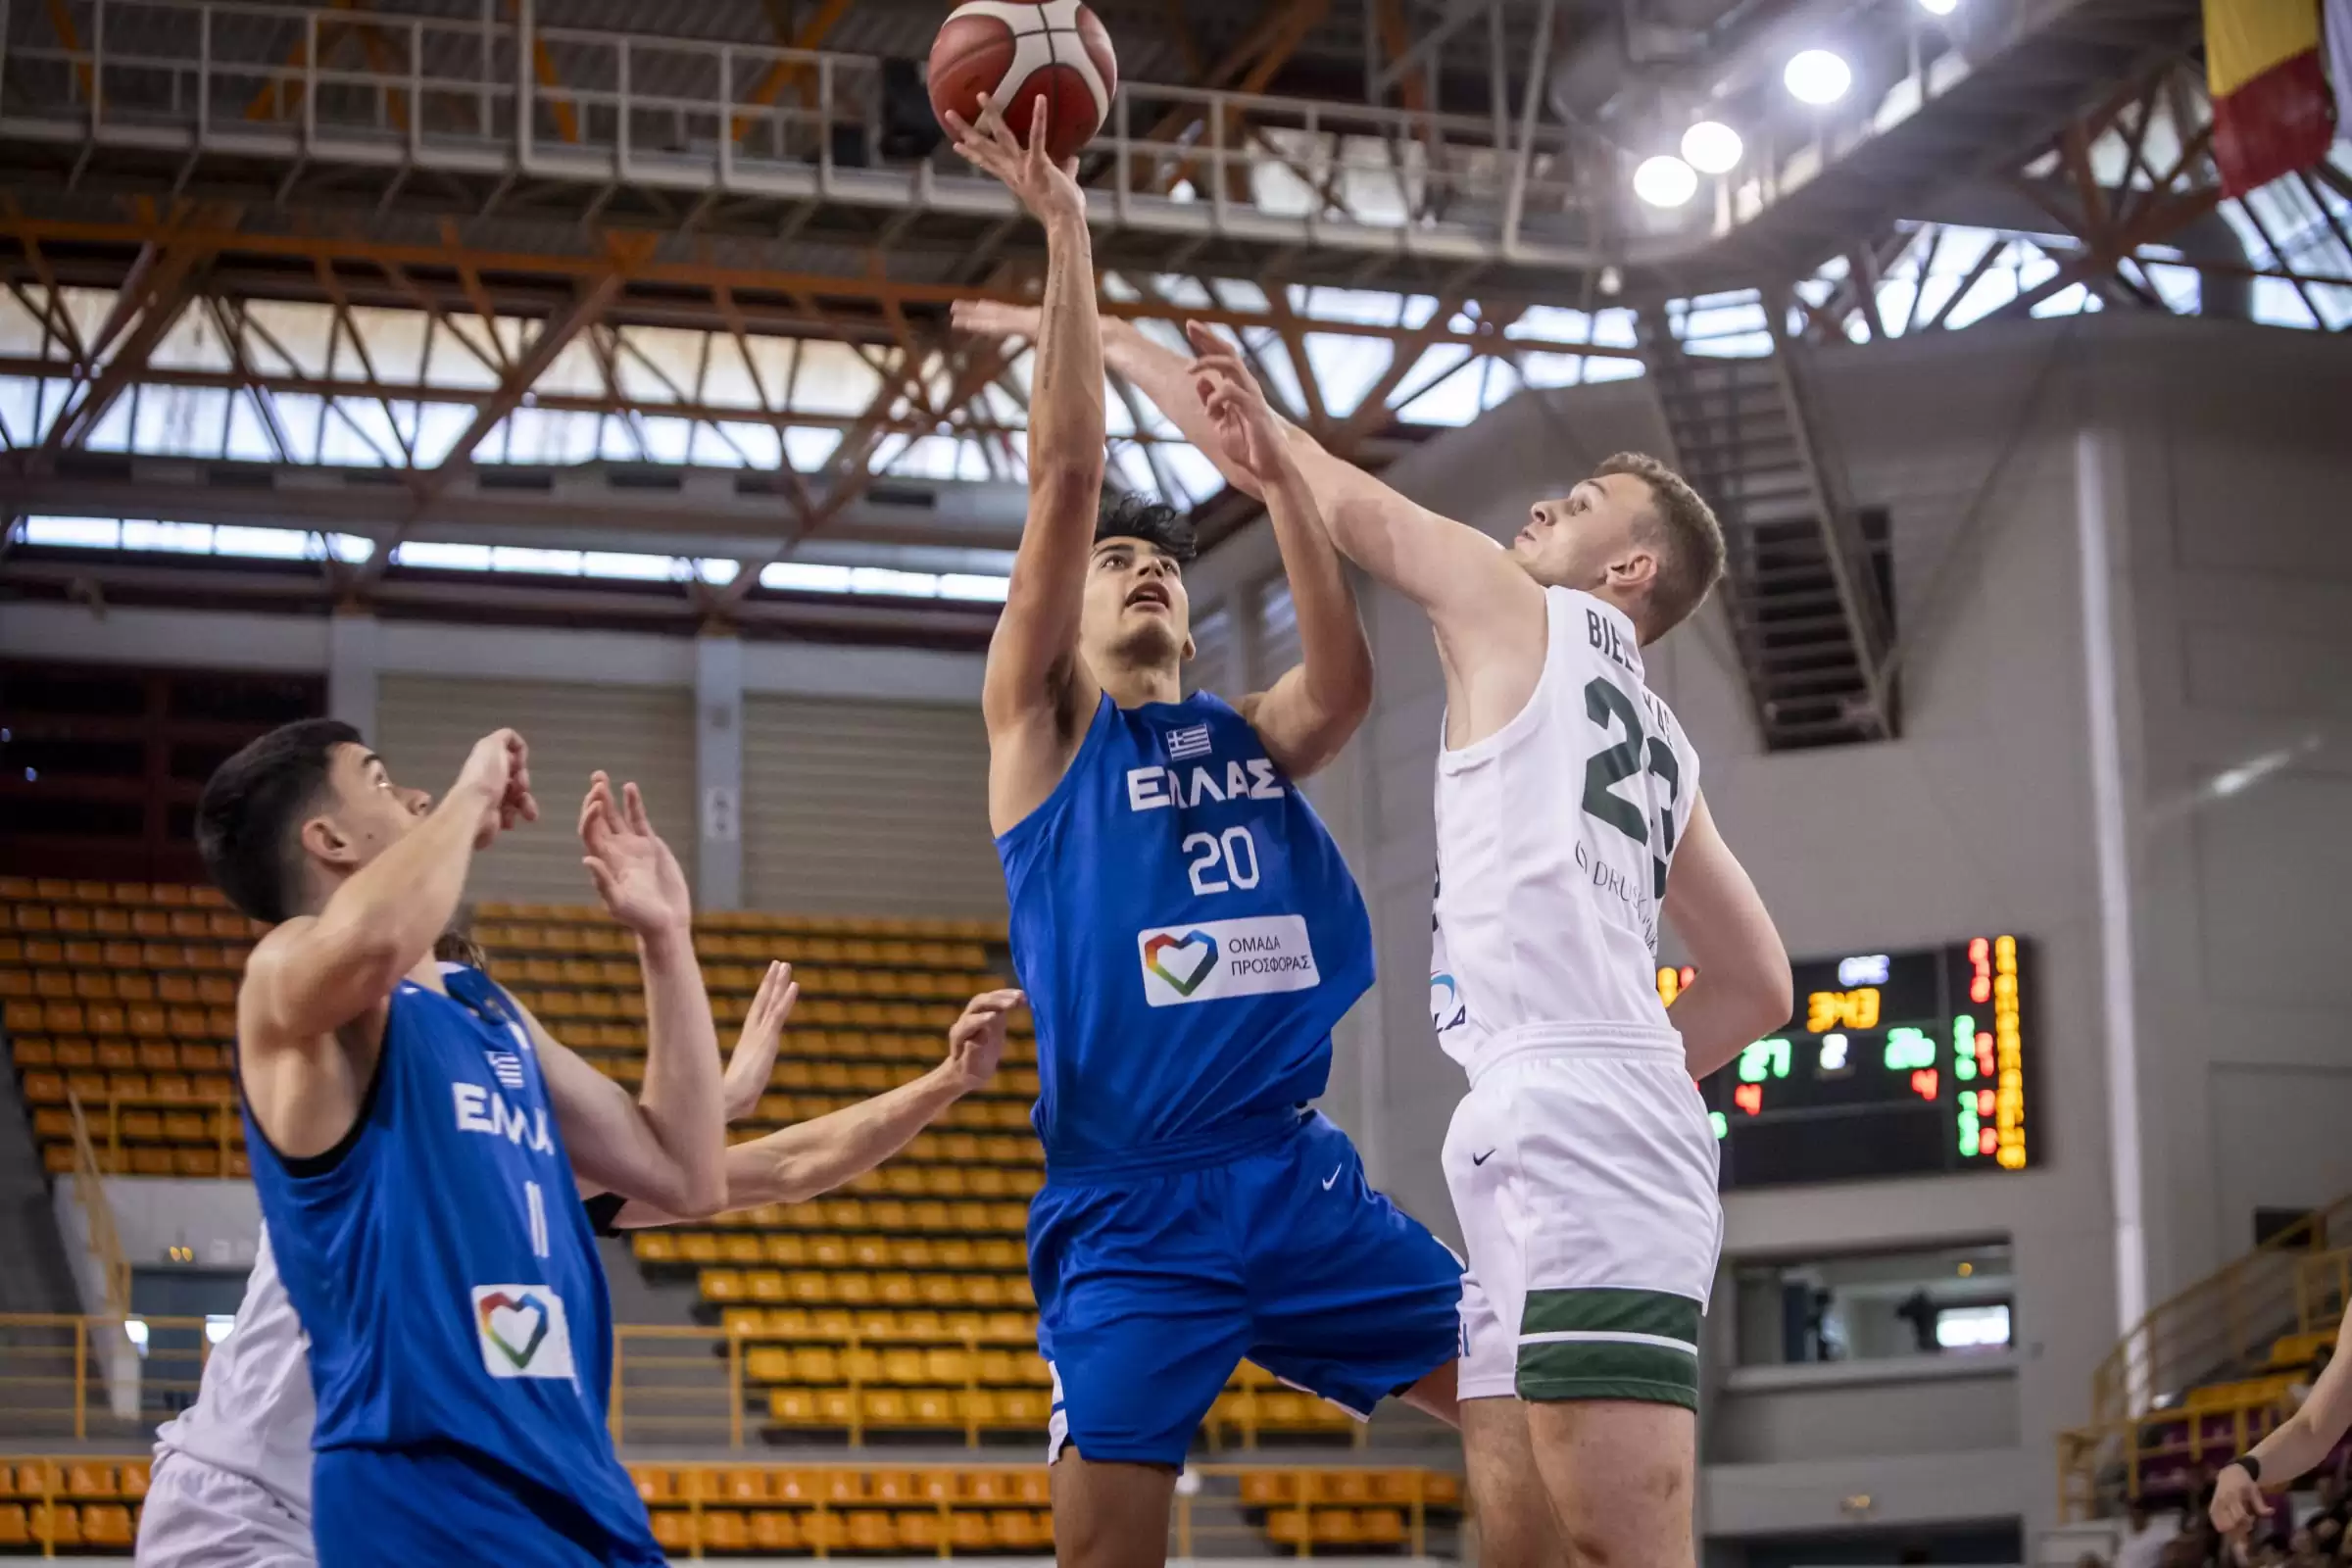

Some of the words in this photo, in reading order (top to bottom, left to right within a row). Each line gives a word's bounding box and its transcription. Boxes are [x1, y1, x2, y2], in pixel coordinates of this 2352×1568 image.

[1182, 825, 1260, 896] 20
[1229, 935, 1281, 954] ΟΜΑΔΑ
[1231, 955, 1311, 976] ΠΡΟΣΦΟΡΑΣ
